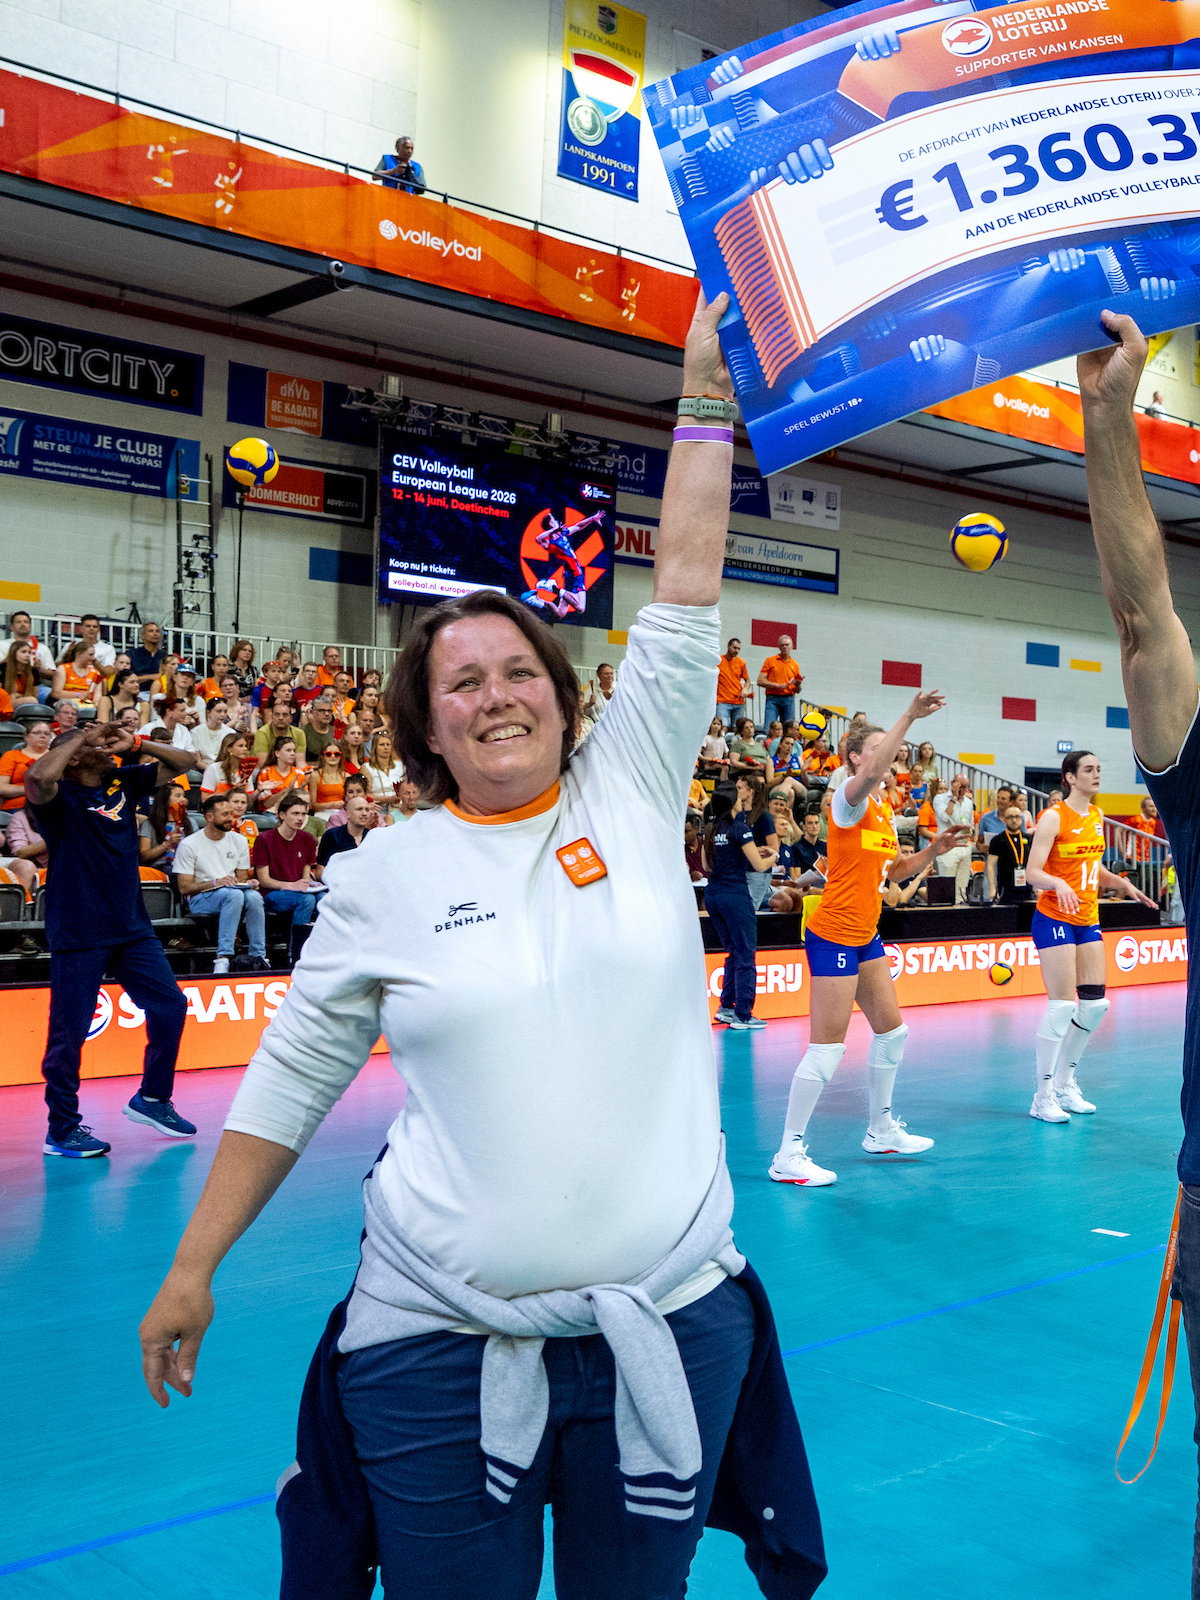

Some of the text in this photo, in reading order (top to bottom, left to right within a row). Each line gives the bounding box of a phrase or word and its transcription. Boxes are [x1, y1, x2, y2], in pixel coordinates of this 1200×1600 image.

[991, 0, 1110, 28] NEDERLANDSE
[997, 17, 1068, 42] LOTERIJ
[955, 34, 1124, 76] SUPPORTER VAN KANSEN
[898, 151, 916, 163] DE
[918, 127, 981, 156] AFDRACHT
[985, 120, 1010, 135] VAN
[1010, 98, 1110, 127] NEDERLANDSE
[1110, 90, 1163, 106] LOTERIJ
[1164, 88, 1195, 99] OVER
[564, 142, 636, 173] LANDSKAMPIOEN
[582, 162, 615, 187] 1991
[875, 179, 929, 231] €
[965, 221, 995, 239] AAN
[997, 214, 1016, 229] DE
[1017, 188, 1120, 222] NEDERLANDSE
[398, 226, 482, 262] volleybal
[271, 400, 282, 413] DE
[783, 397, 863, 435] SPEEL BEWUST, 18+
[1004, 397, 1050, 419] volleybal
[33, 439, 56, 451] MET
[57, 444, 72, 454] DE
[120, 453, 162, 468] WASPAS!
[34, 424, 163, 458] STEUN JE CLUB!
[392, 453, 474, 480] CEV Volleyball
[249, 486, 320, 508] DOMMERHOLT
[392, 470, 516, 504] European League 2026
[392, 488, 404, 500] 12
[413, 491, 425, 503] 14
[451, 498, 510, 518] Doetinchem
[737, 541, 803, 562] van Apeldoorn
[389, 558, 456, 576] Koop nu je tickets:
[1075, 844, 1105, 855] DHL
[1081, 860, 1099, 891] 14
[435, 911, 496, 933] DENHAM
[1052, 926, 1066, 940] 14
[837, 953, 847, 969] 5
[118, 981, 293, 1029] SAATS
